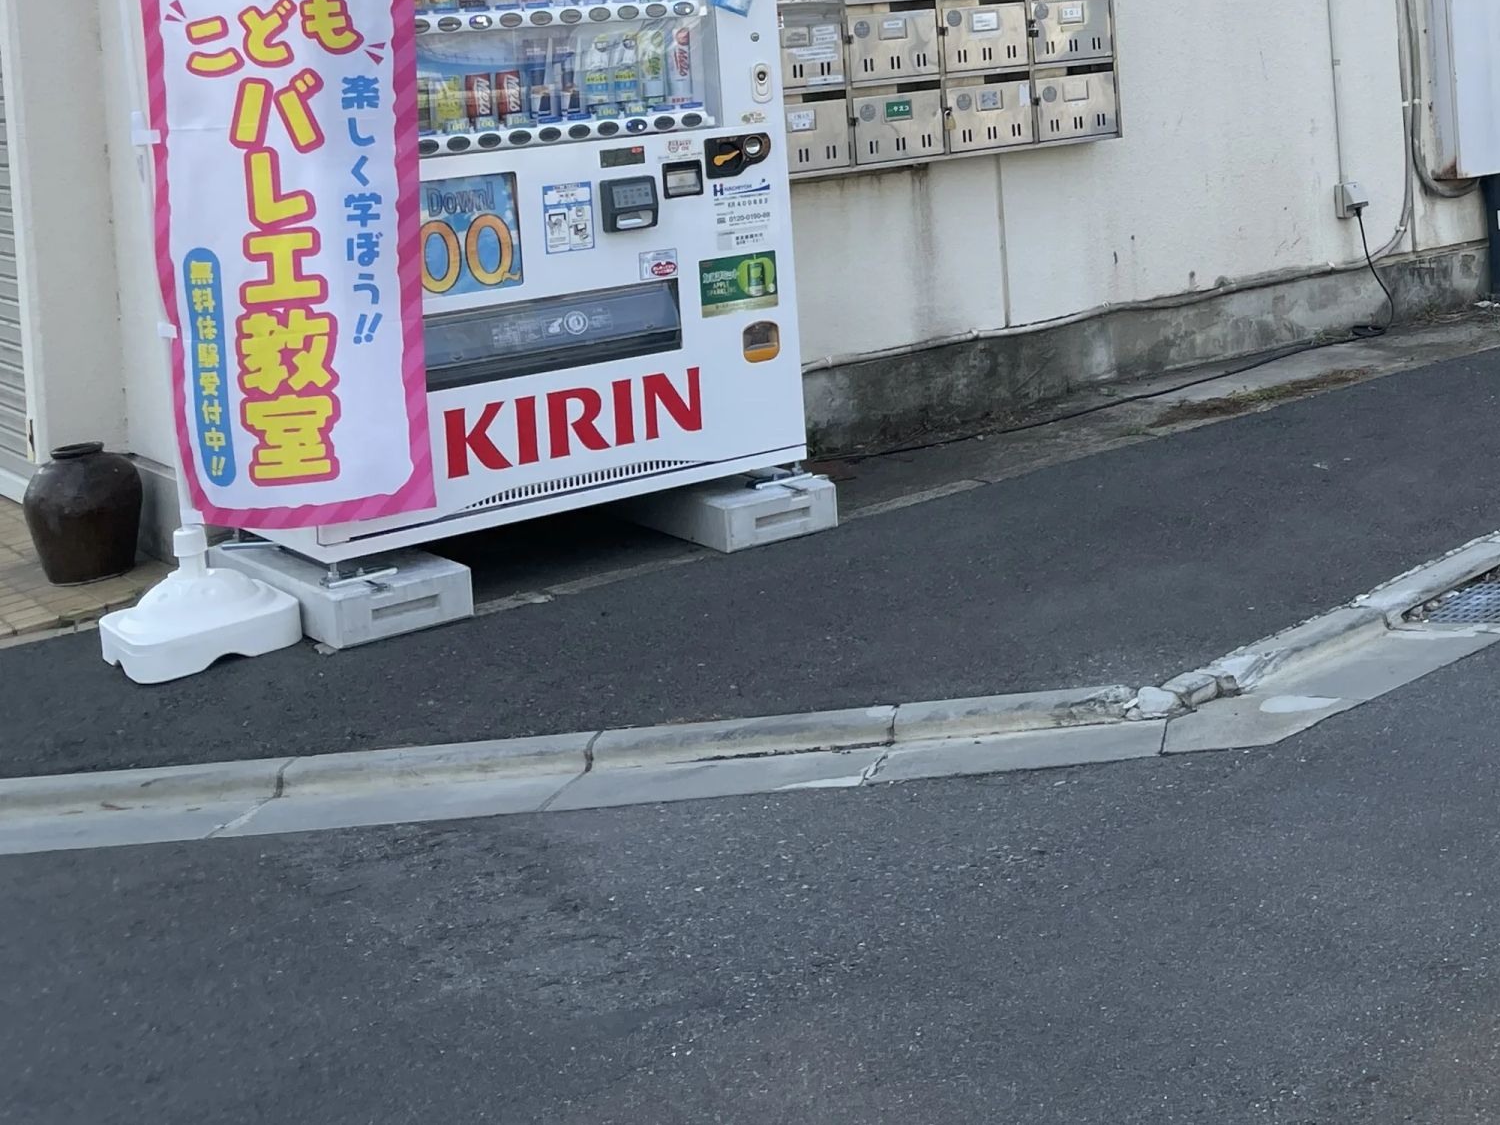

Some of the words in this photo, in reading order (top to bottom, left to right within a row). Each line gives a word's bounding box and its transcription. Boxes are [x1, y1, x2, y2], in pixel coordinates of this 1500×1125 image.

[426, 181, 496, 217] Down!
[229, 68, 340, 487] バレエ教室
[443, 366, 703, 479] KIRIN
